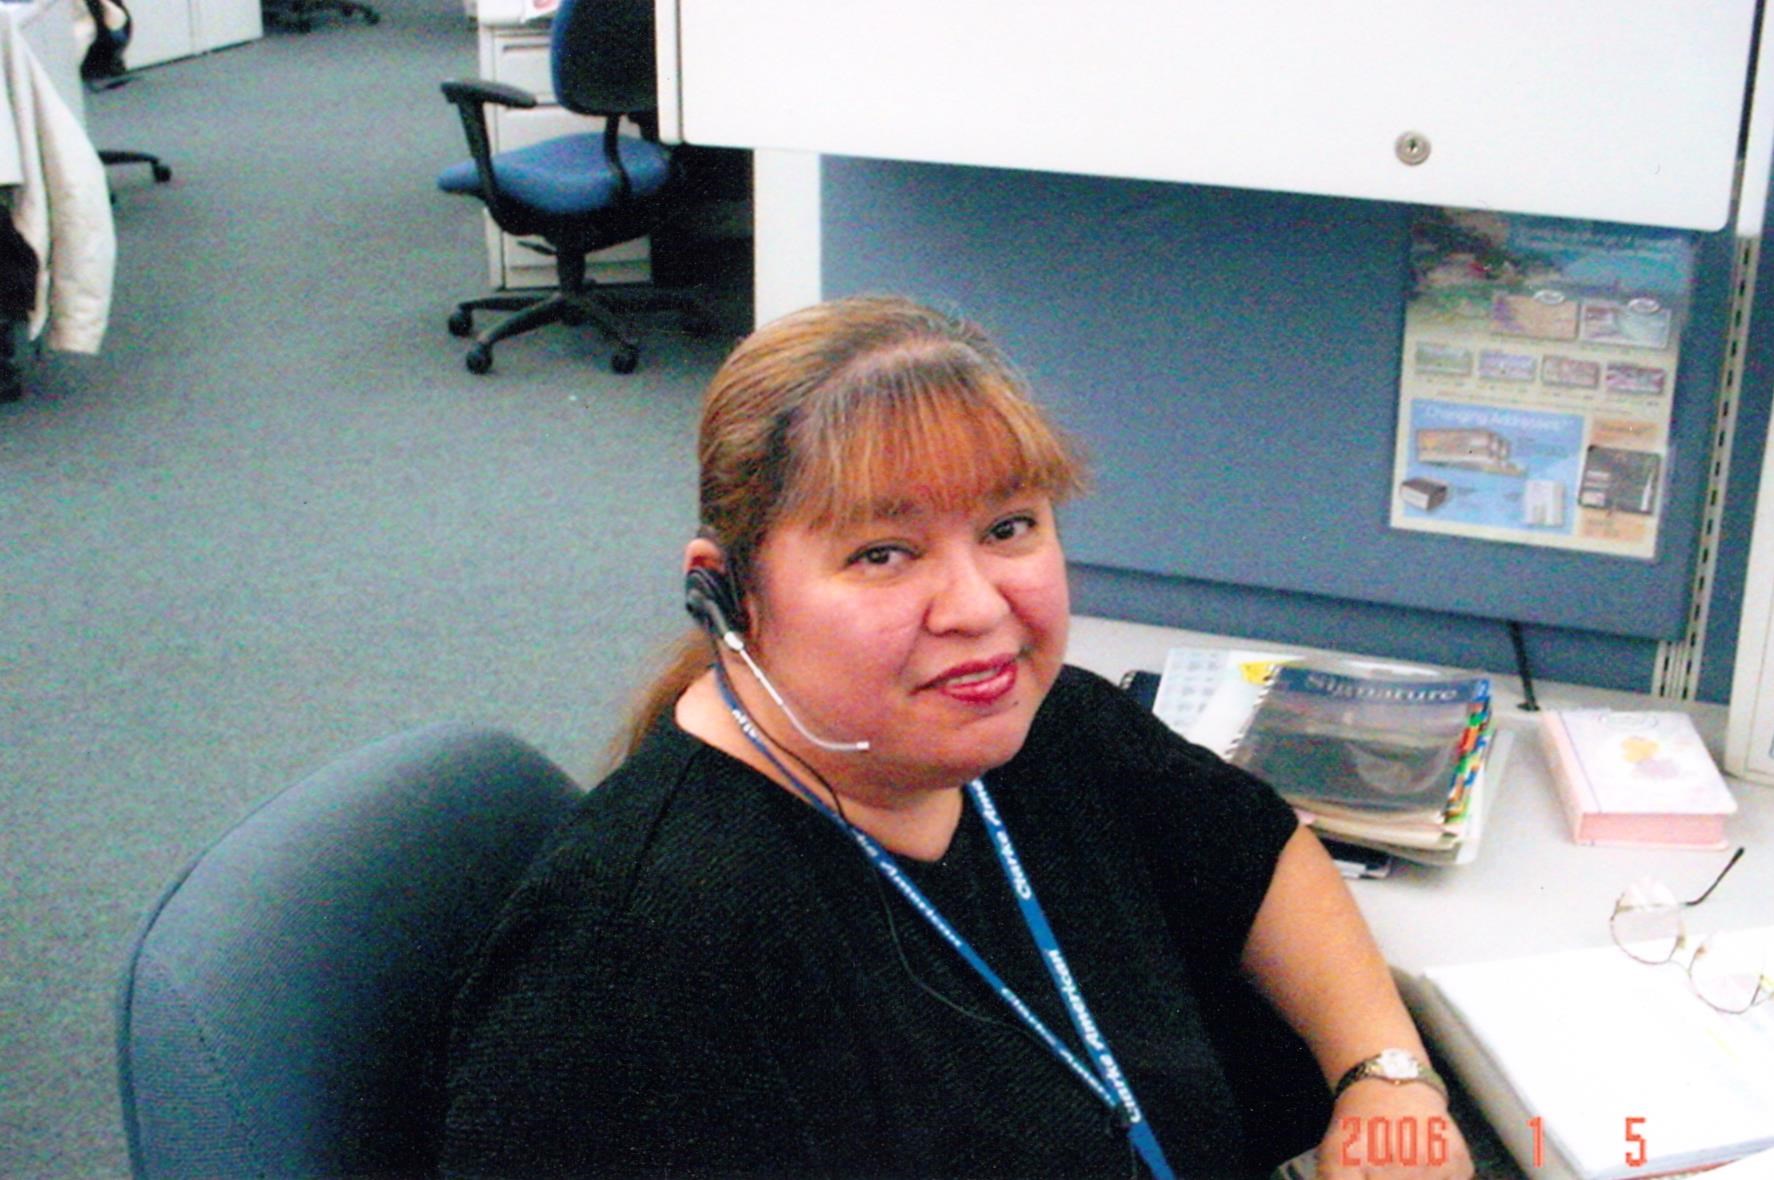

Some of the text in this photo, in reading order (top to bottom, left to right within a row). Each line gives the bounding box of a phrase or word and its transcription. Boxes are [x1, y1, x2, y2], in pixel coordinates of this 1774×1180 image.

[1305, 672, 1459, 702] Signature
[1048, 949, 1141, 1123] Clarke American
